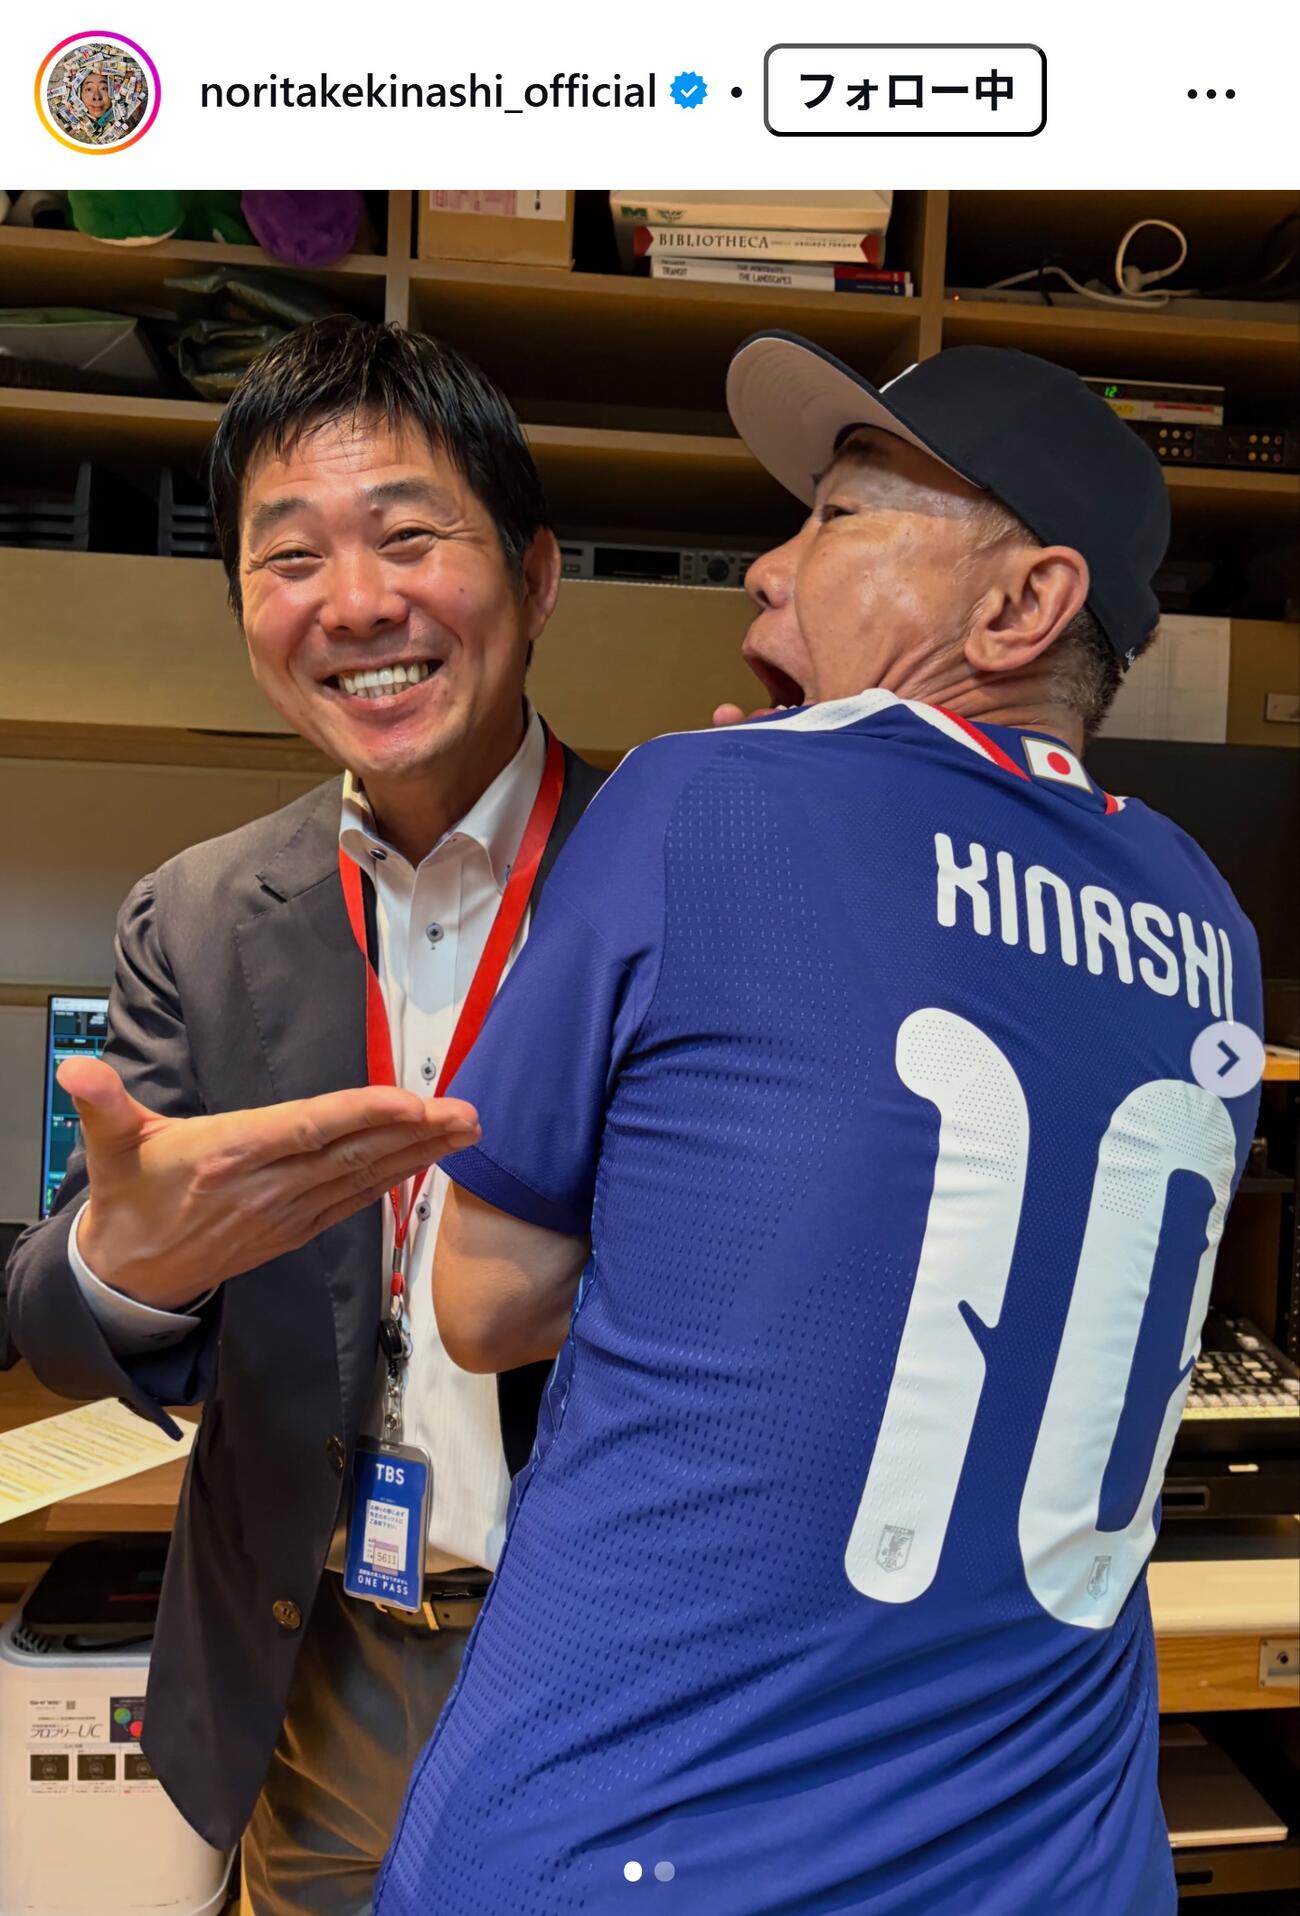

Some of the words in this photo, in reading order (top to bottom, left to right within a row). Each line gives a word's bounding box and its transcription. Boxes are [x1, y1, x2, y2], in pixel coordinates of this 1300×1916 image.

[658, 232, 770, 249] BIBLIOTHECA
[934, 832, 1234, 1024] KINASHI
[845, 1007, 1237, 1629] 10
[375, 1463, 405, 1486] TBS
[357, 1574, 378, 1588] ONE
[382, 1580, 409, 1596] PASS
